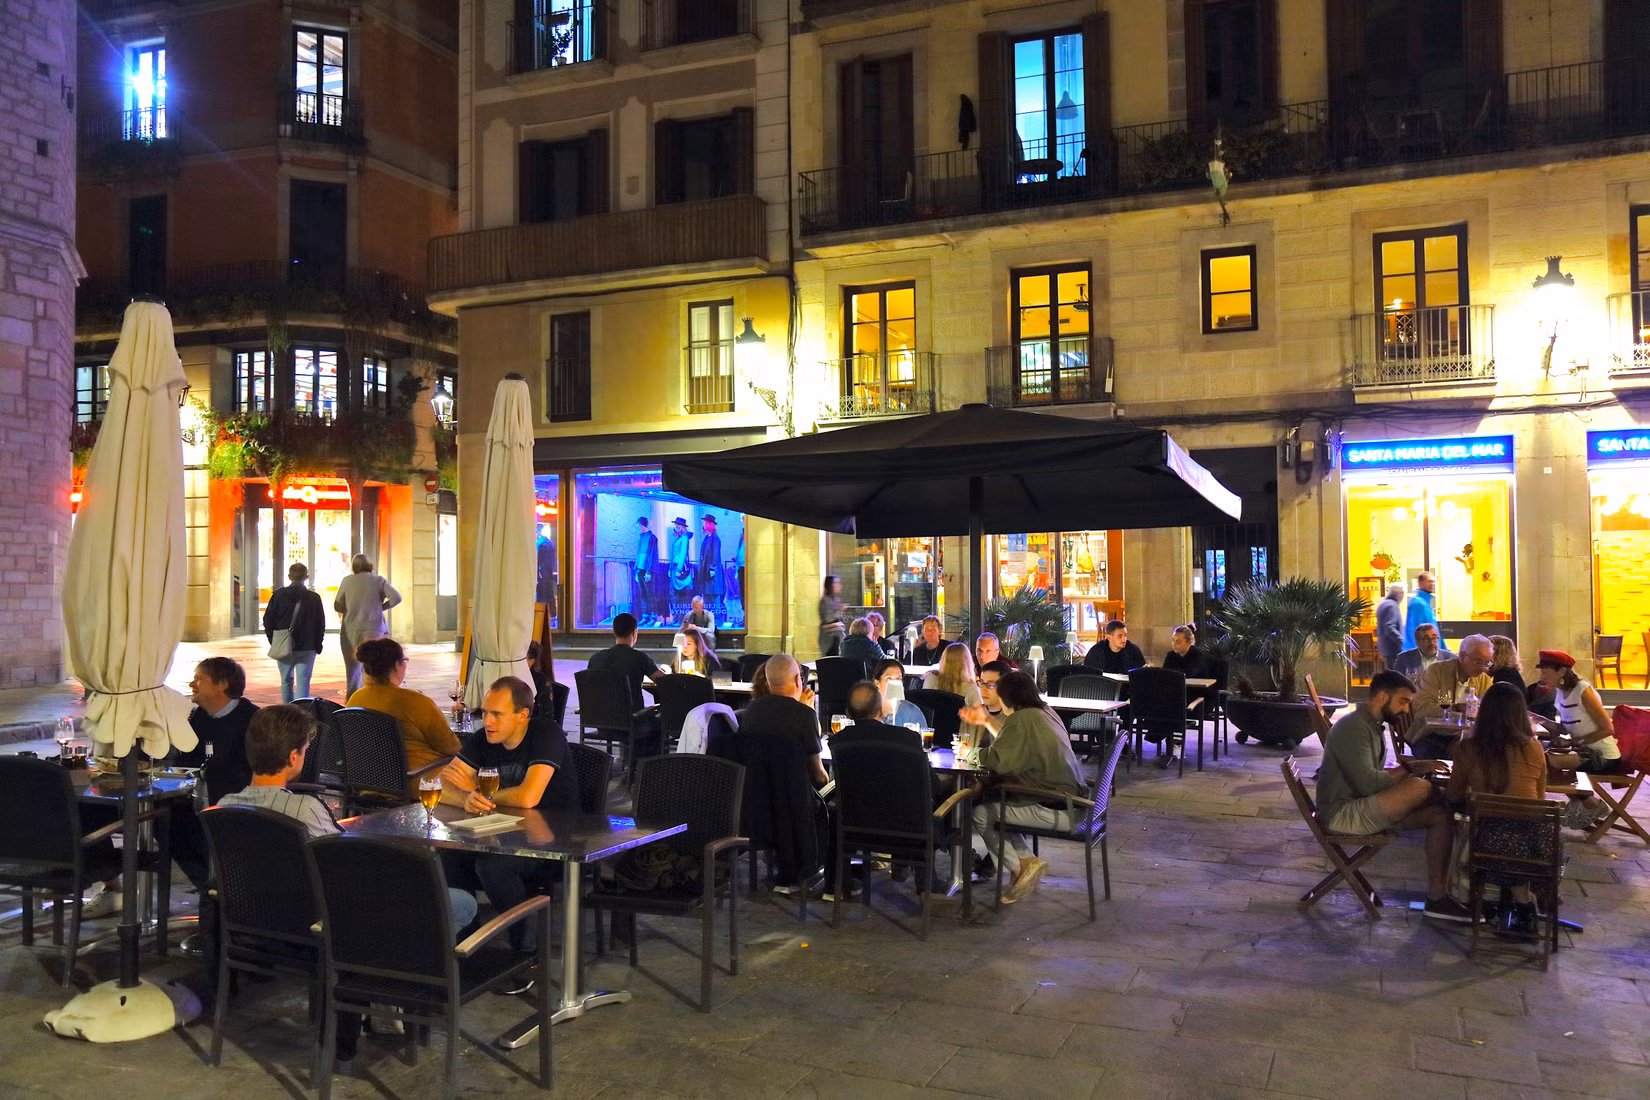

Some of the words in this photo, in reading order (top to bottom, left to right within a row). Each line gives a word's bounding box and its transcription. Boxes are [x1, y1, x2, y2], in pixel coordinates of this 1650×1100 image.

[1348, 449, 1393, 463] SANTA
[1395, 447, 1441, 461] MARIA
[1442, 445, 1470, 459] DEL
[1471, 443, 1505, 457] MAR
[1597, 437, 1649, 452] SANTA
